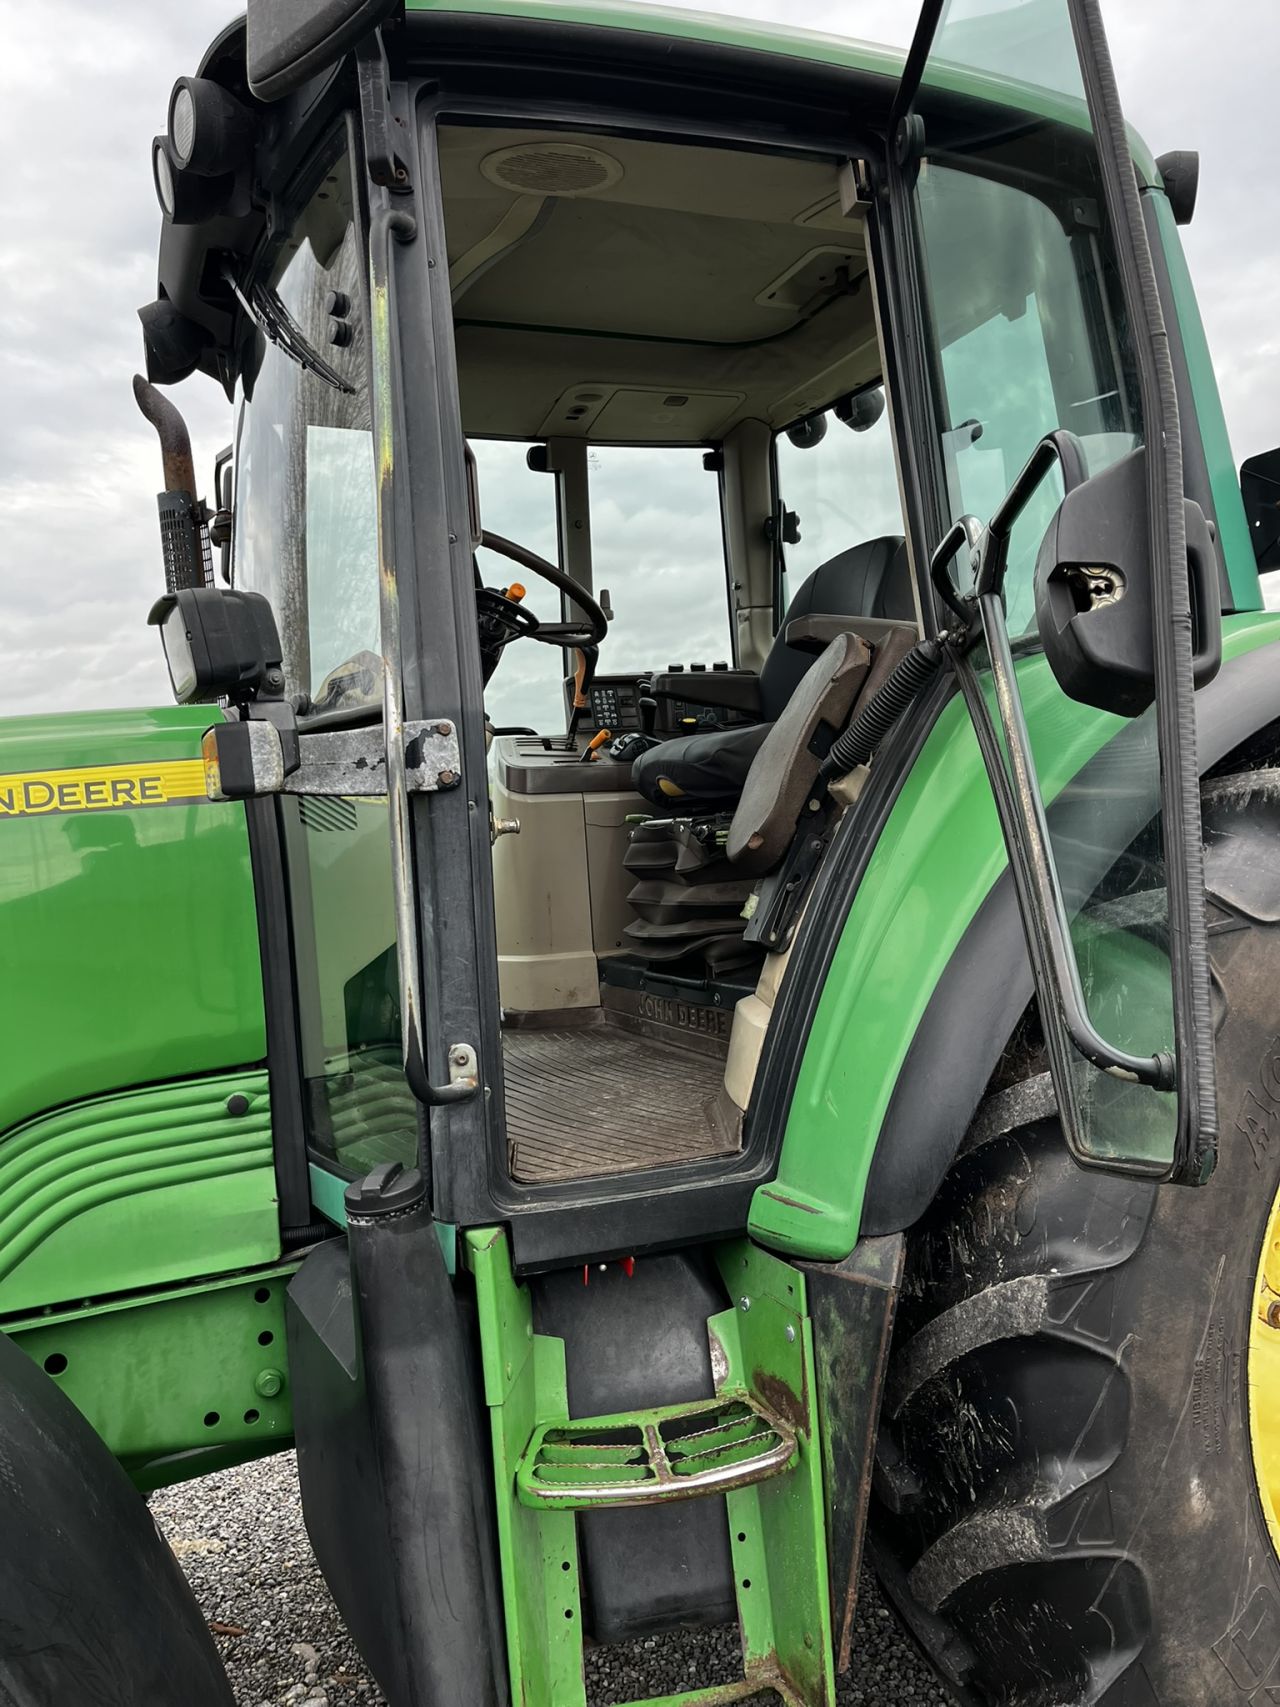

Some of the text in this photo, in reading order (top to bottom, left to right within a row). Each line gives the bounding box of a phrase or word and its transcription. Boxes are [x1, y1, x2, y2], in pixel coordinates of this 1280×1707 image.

[22, 776, 164, 810] DEERE
[637, 993, 728, 1034] JOHN DEERE
